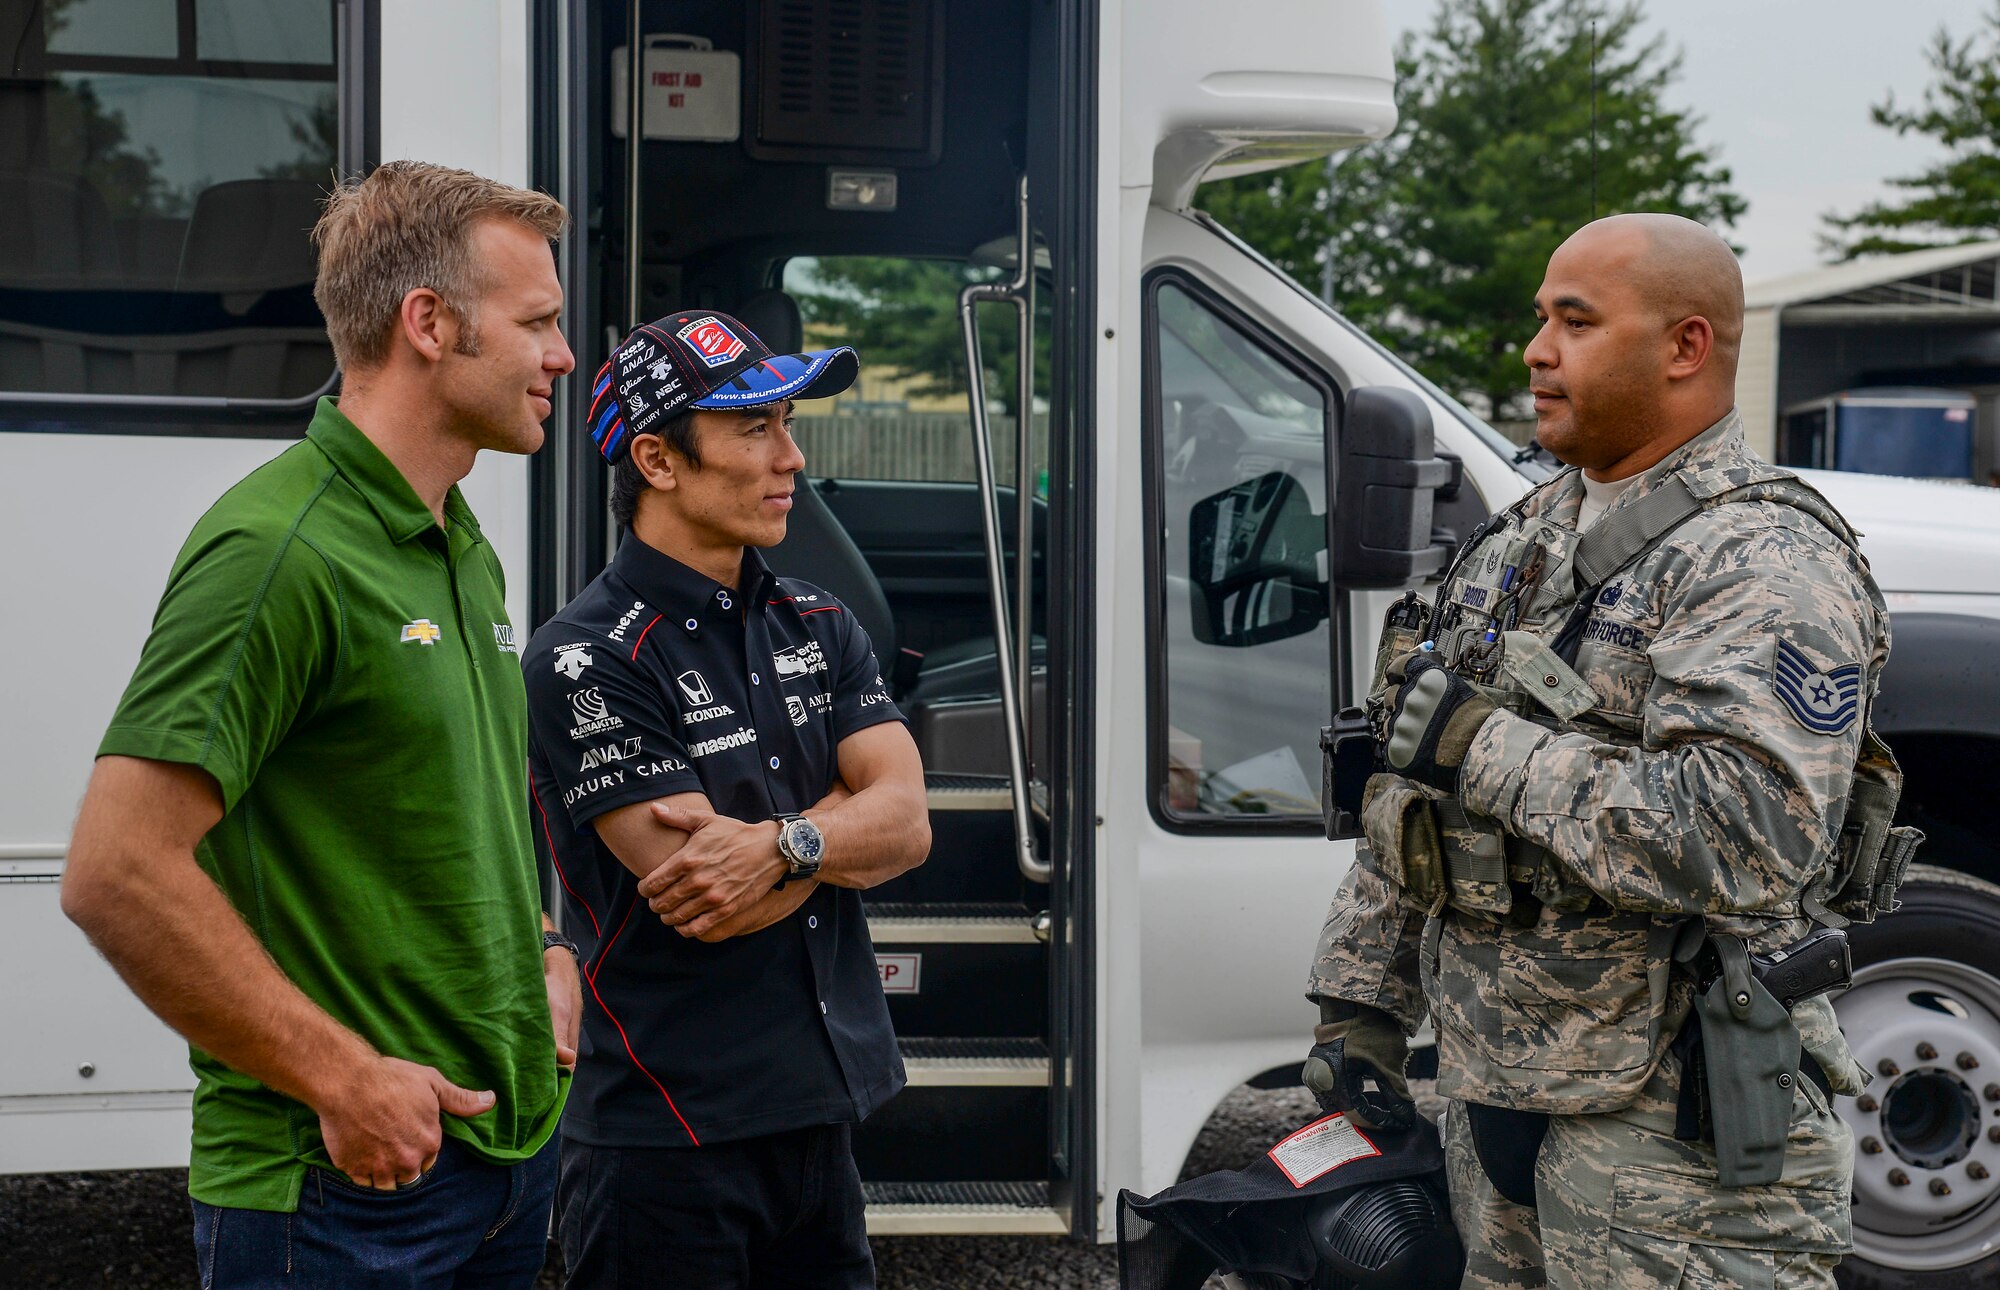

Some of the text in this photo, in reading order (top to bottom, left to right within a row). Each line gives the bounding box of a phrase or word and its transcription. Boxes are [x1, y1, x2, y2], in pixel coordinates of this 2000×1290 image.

[652, 72, 703, 88] FIRST AID
[668, 93, 685, 108] KIT
[622, 355, 644, 377] ANA
[712, 357, 823, 400] www.takumasato.com
[633, 408, 661, 433] LUXURY
[663, 392, 688, 410] CARD
[553, 642, 592, 654] DESCENTE
[682, 704, 736, 725] HONDA
[687, 726, 757, 759] anasonic
[580, 743, 623, 772] ANA
[1294, 1124, 1329, 1142] WARNING
